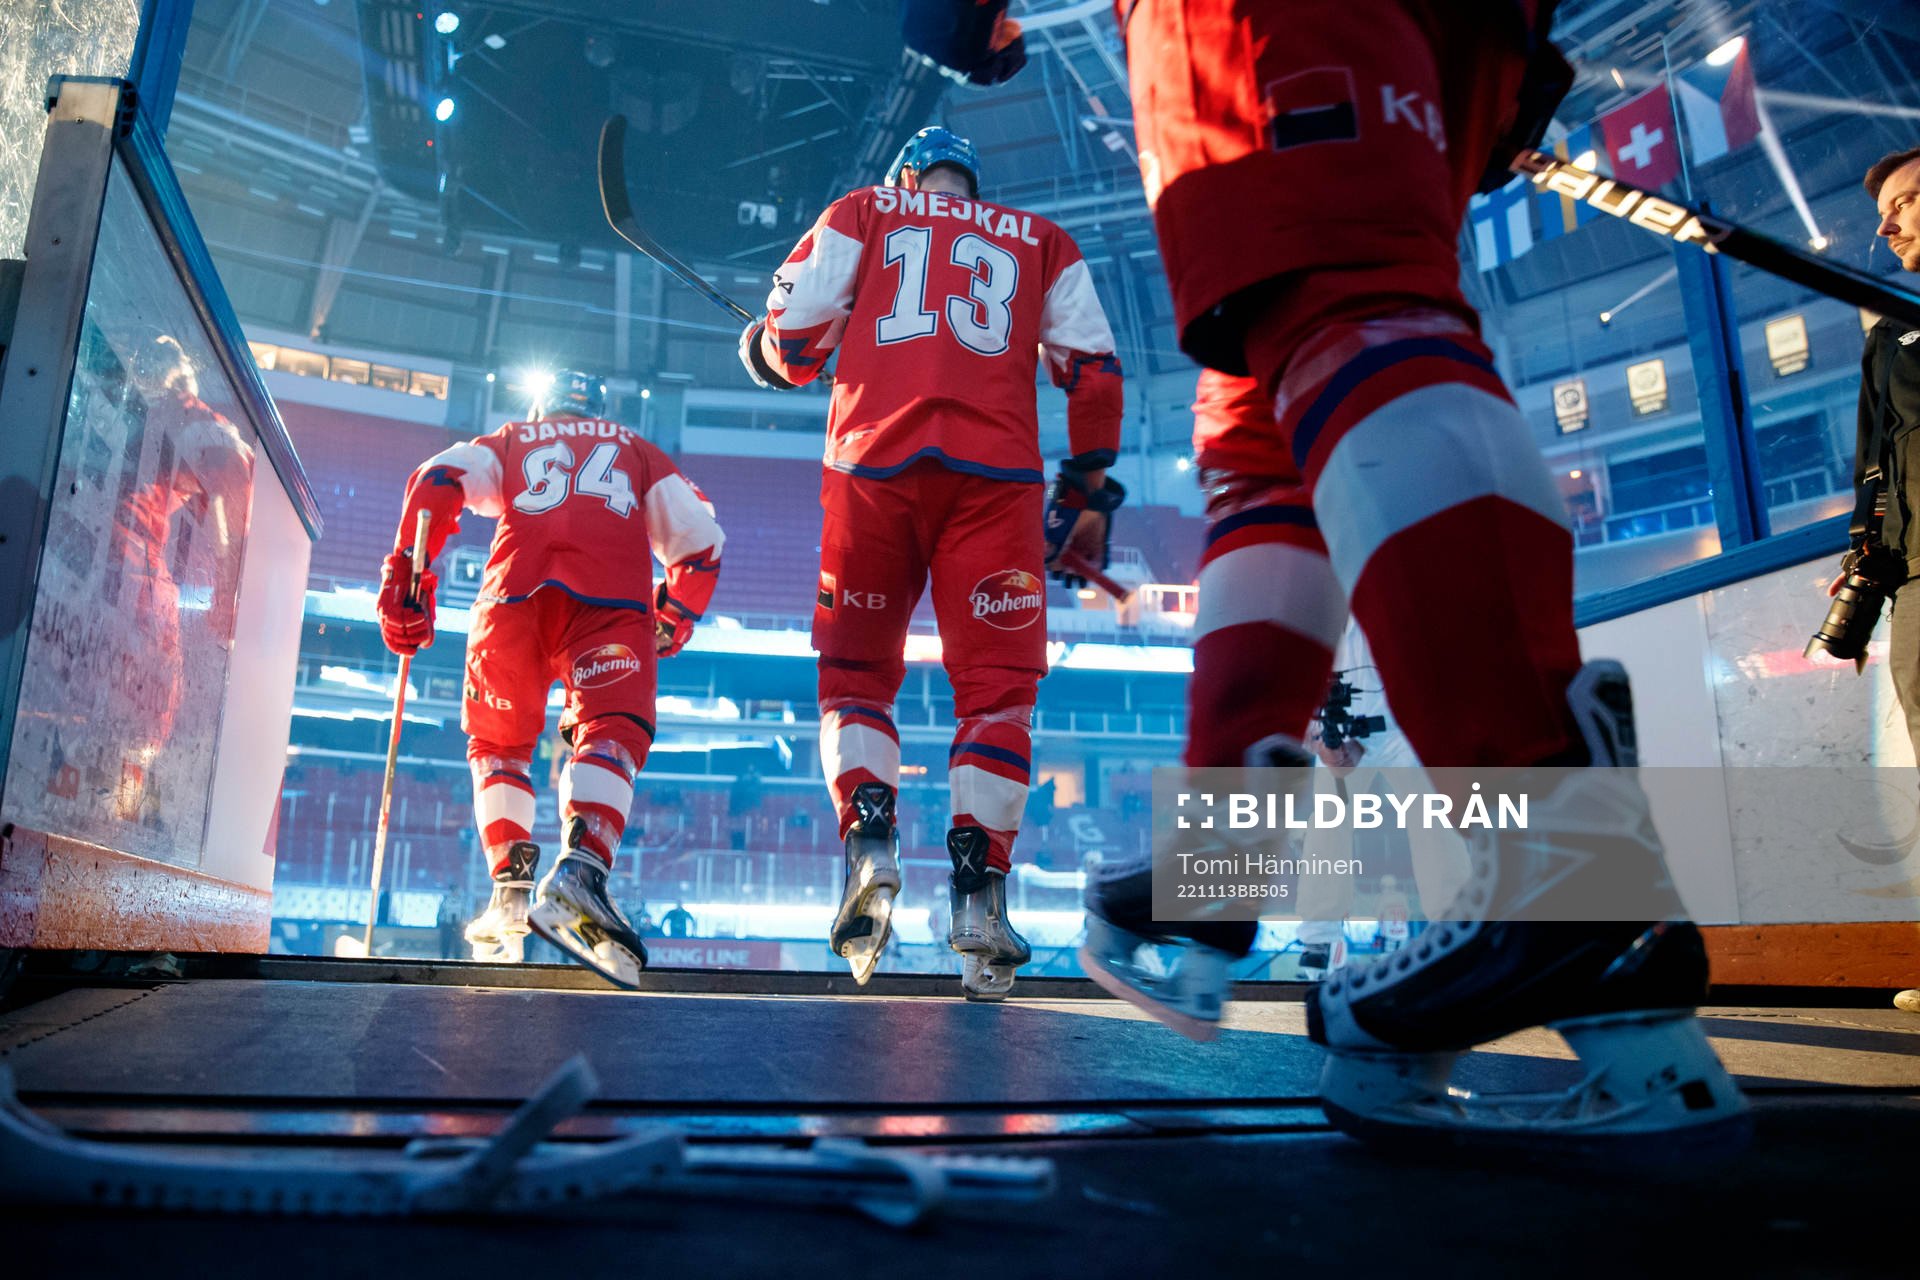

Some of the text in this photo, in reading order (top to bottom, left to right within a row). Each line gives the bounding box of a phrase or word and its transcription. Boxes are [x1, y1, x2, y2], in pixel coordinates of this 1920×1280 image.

[875, 187, 1040, 247] SMEJKAL
[876, 225, 1019, 357] 13
[512, 440, 639, 519] 64
[843, 589, 887, 610] KB
[970, 589, 1042, 618] Bohemi
[484, 690, 513, 711] KB
[706, 949, 750, 967] LINE
